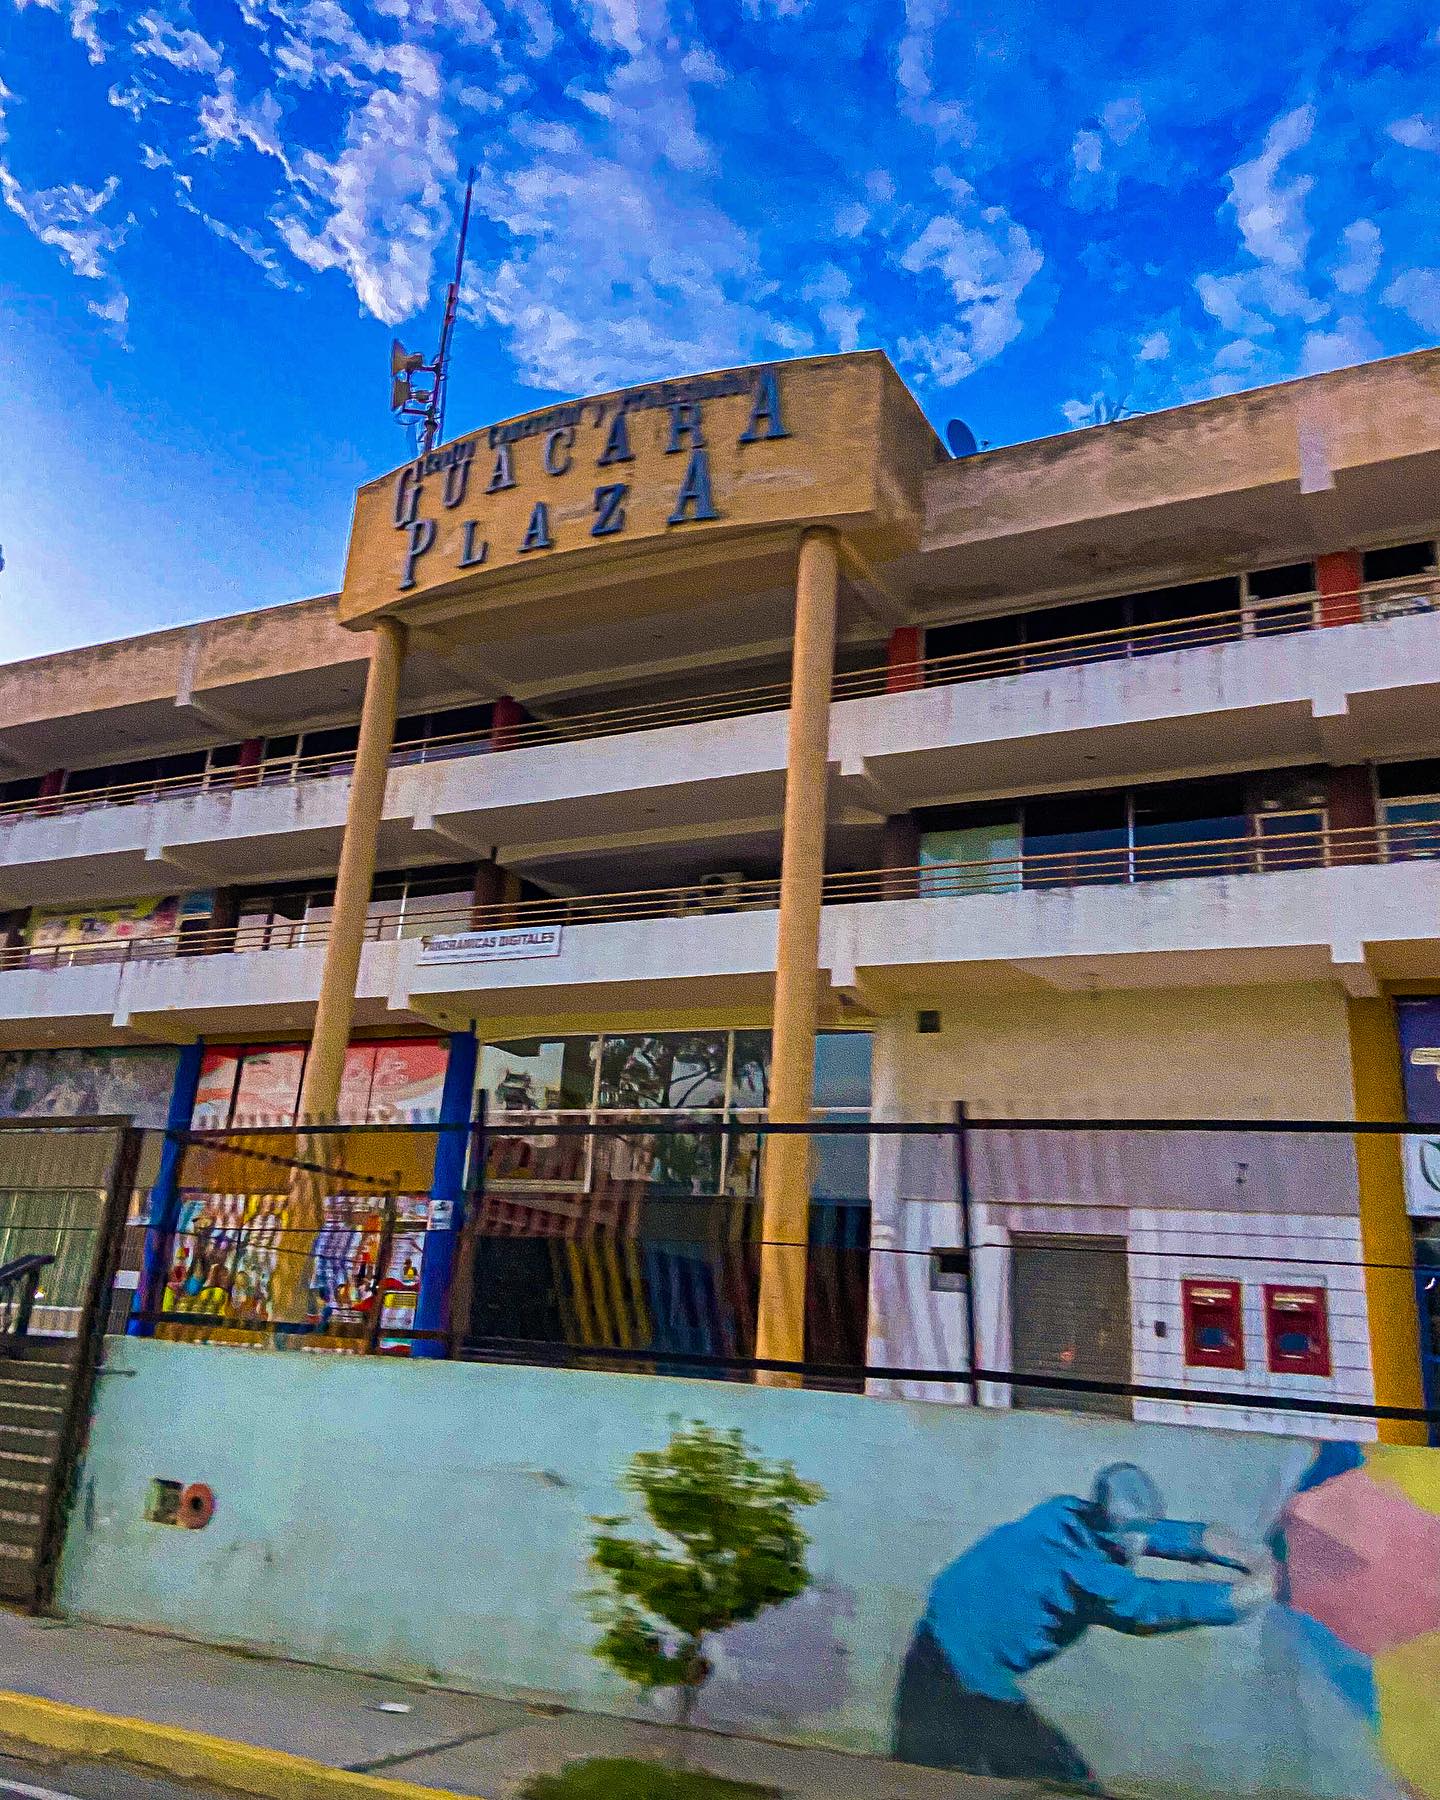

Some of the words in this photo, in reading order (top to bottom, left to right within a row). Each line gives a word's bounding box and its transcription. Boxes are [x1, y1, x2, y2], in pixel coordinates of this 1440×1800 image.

[395, 365, 792, 530] GUACARA
[398, 448, 720, 591] PLAZA
[498, 932, 555, 947] DIGITALES
